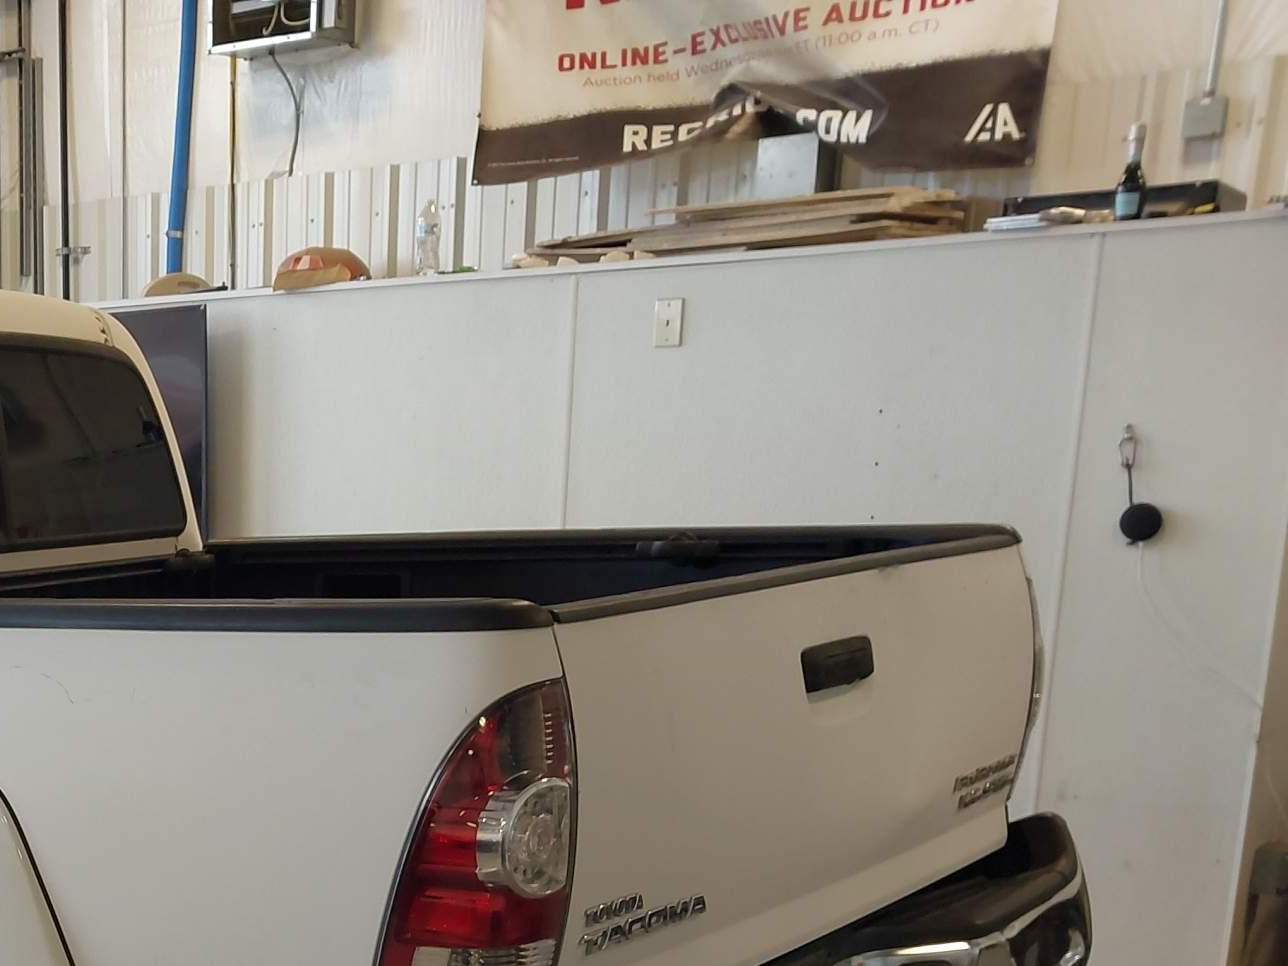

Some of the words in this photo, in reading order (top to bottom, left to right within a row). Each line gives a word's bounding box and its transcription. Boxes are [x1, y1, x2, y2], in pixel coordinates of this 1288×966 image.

[558, 7, 811, 72] ONLINE-EXCLUSIVE
[821, 0, 976, 26] AUCTI
[582, 73, 642, 88] Auction
[648, 69, 680, 82] held
[577, 895, 708, 956] TACOMA
